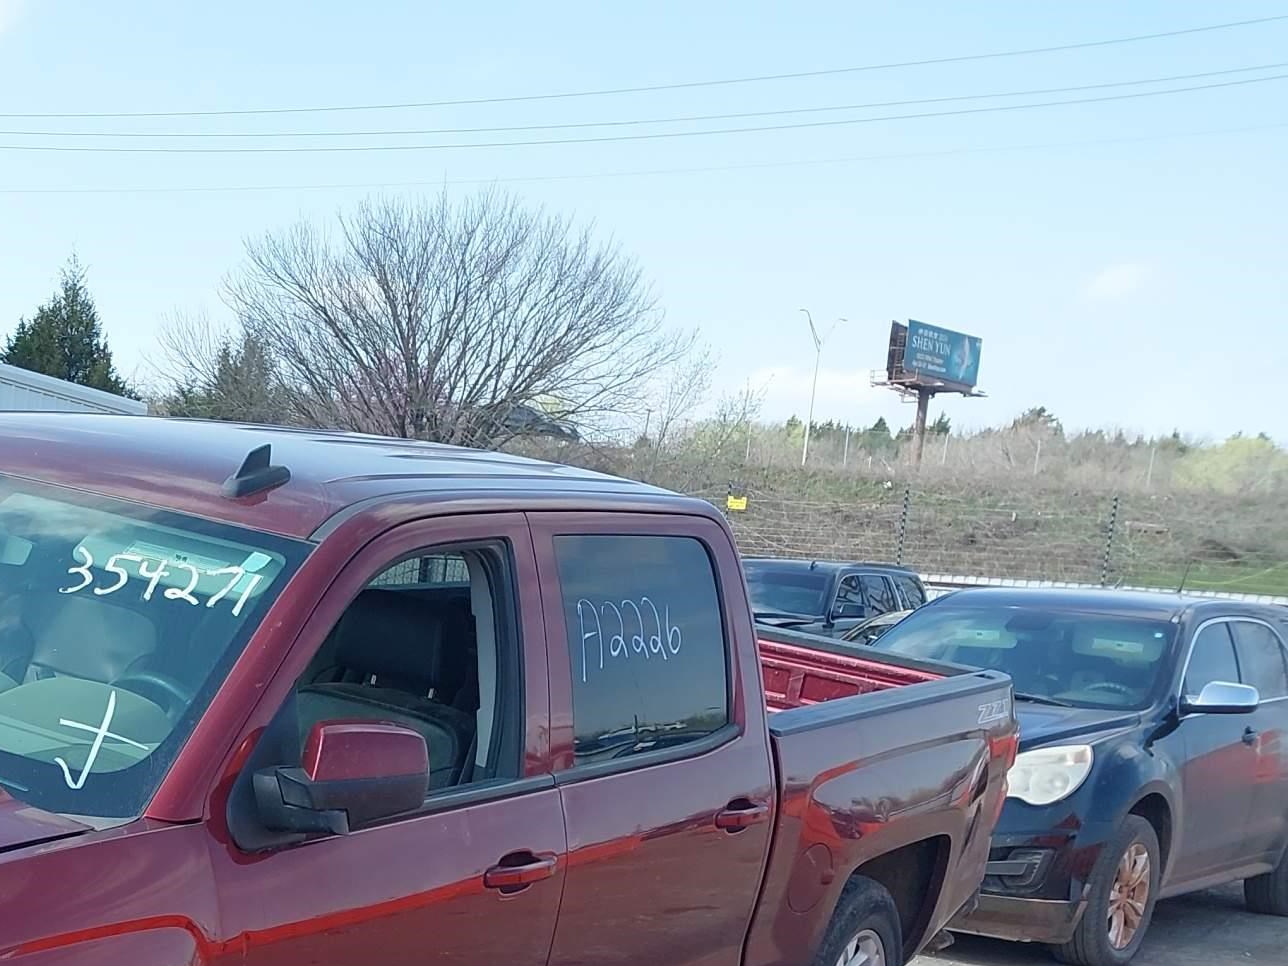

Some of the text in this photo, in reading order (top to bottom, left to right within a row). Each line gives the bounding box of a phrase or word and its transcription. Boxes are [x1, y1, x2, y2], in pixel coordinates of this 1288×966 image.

[912, 335, 933, 352] SHEN
[934, 341, 952, 356] YUN
[58, 546, 264, 617] 354271
